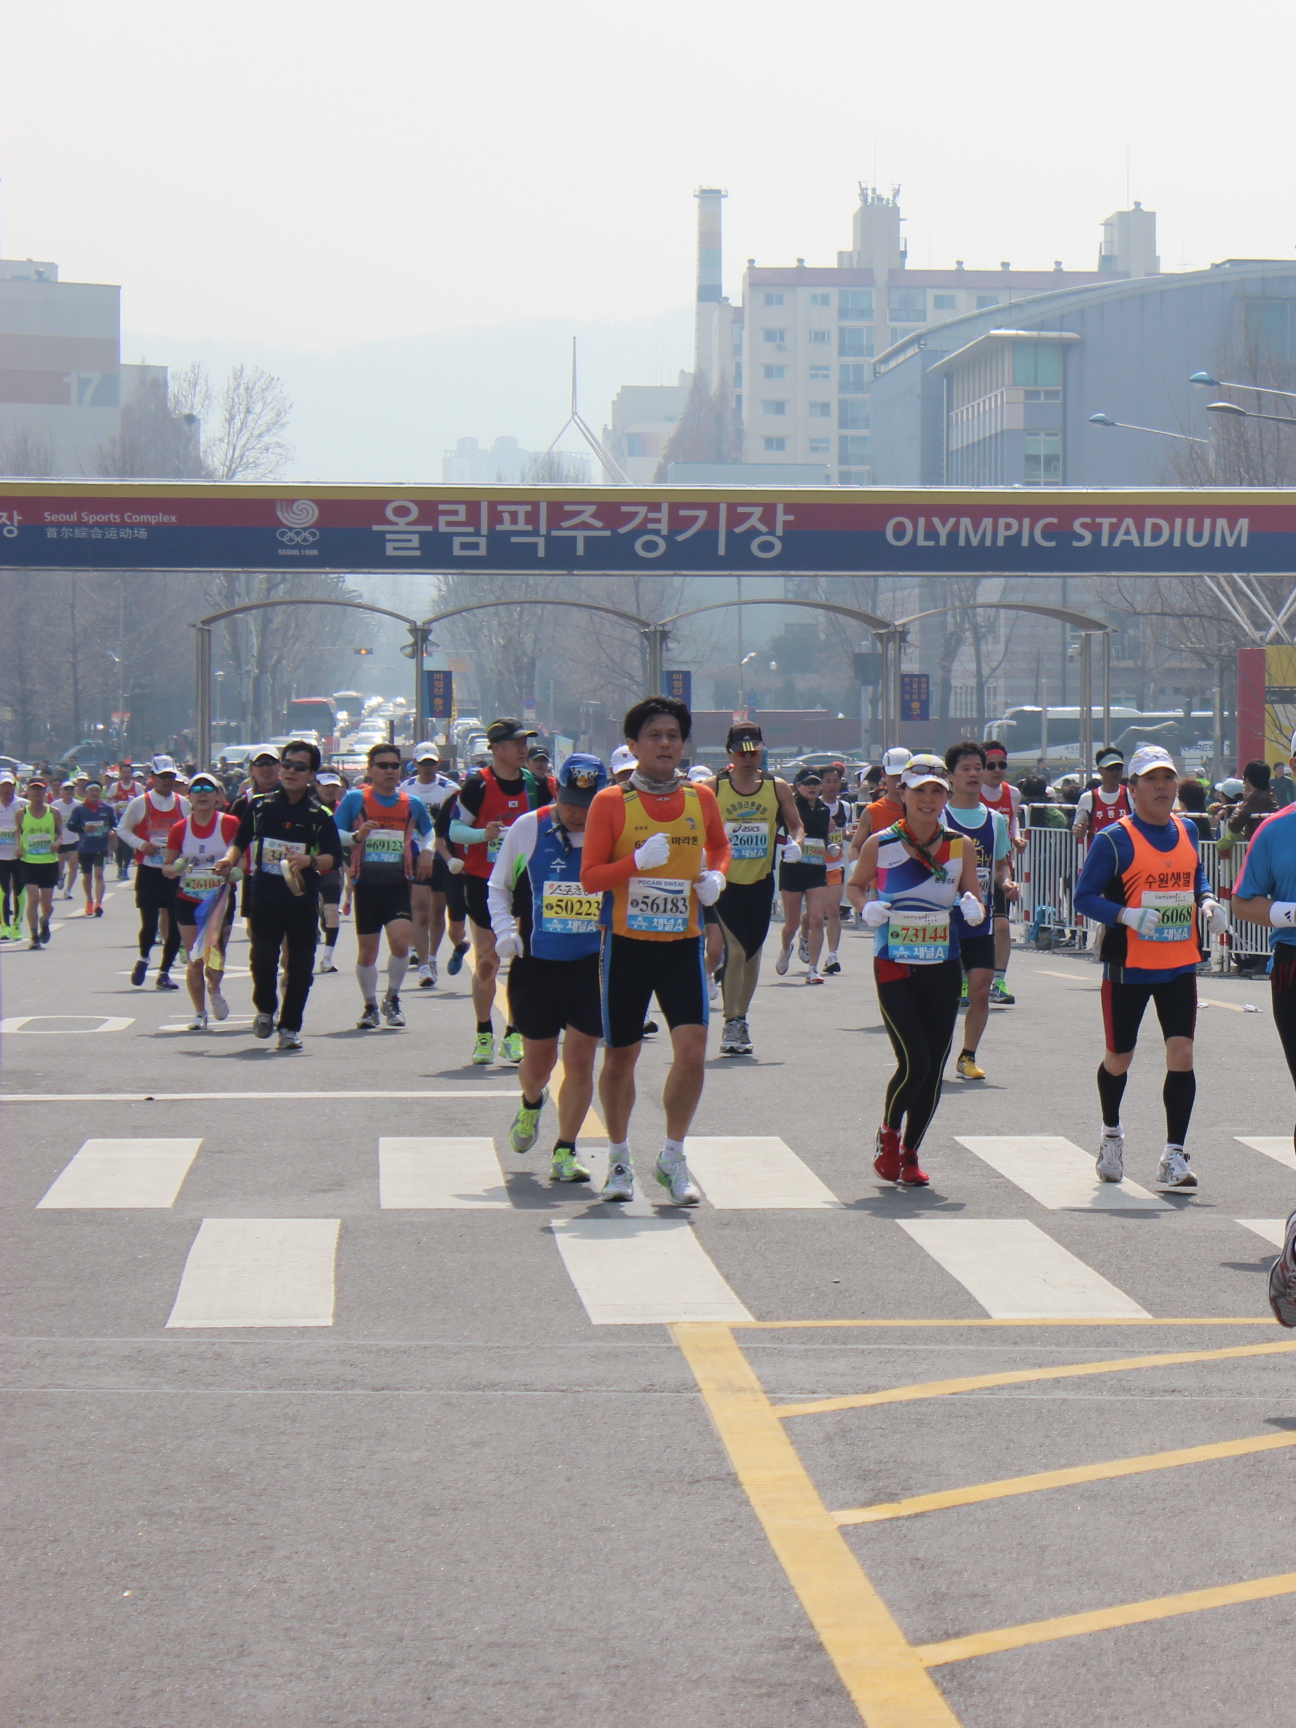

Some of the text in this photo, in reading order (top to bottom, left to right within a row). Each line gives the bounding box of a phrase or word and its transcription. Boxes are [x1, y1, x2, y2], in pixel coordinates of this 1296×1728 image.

[63, 371, 102, 406] 17
[43, 511, 177, 525] Seoul Sports Complex
[371, 500, 795, 559] 올림픽주경기장
[885, 516, 1250, 549] OLYMPIC STADIUM
[910, 701, 921, 716] 출구
[741, 825, 761, 833] asics
[372, 840, 403, 852] 69123
[671, 836, 698, 846] 마라톤
[732, 834, 767, 846] 26010
[549, 858, 567, 873] 수
[1144, 871, 1191, 889] 수원샛별
[554, 898, 601, 917] 50223
[639, 895, 688, 915] 56183
[904, 913, 929, 921] samyang
[1152, 906, 1193, 925] 6068
[566, 919, 596, 933] 채널A
[652, 918, 685, 931] 채널A
[900, 925, 949, 943] 73144
[1162, 926, 1189, 941] 채널A
[913, 946, 945, 960] 채널A
